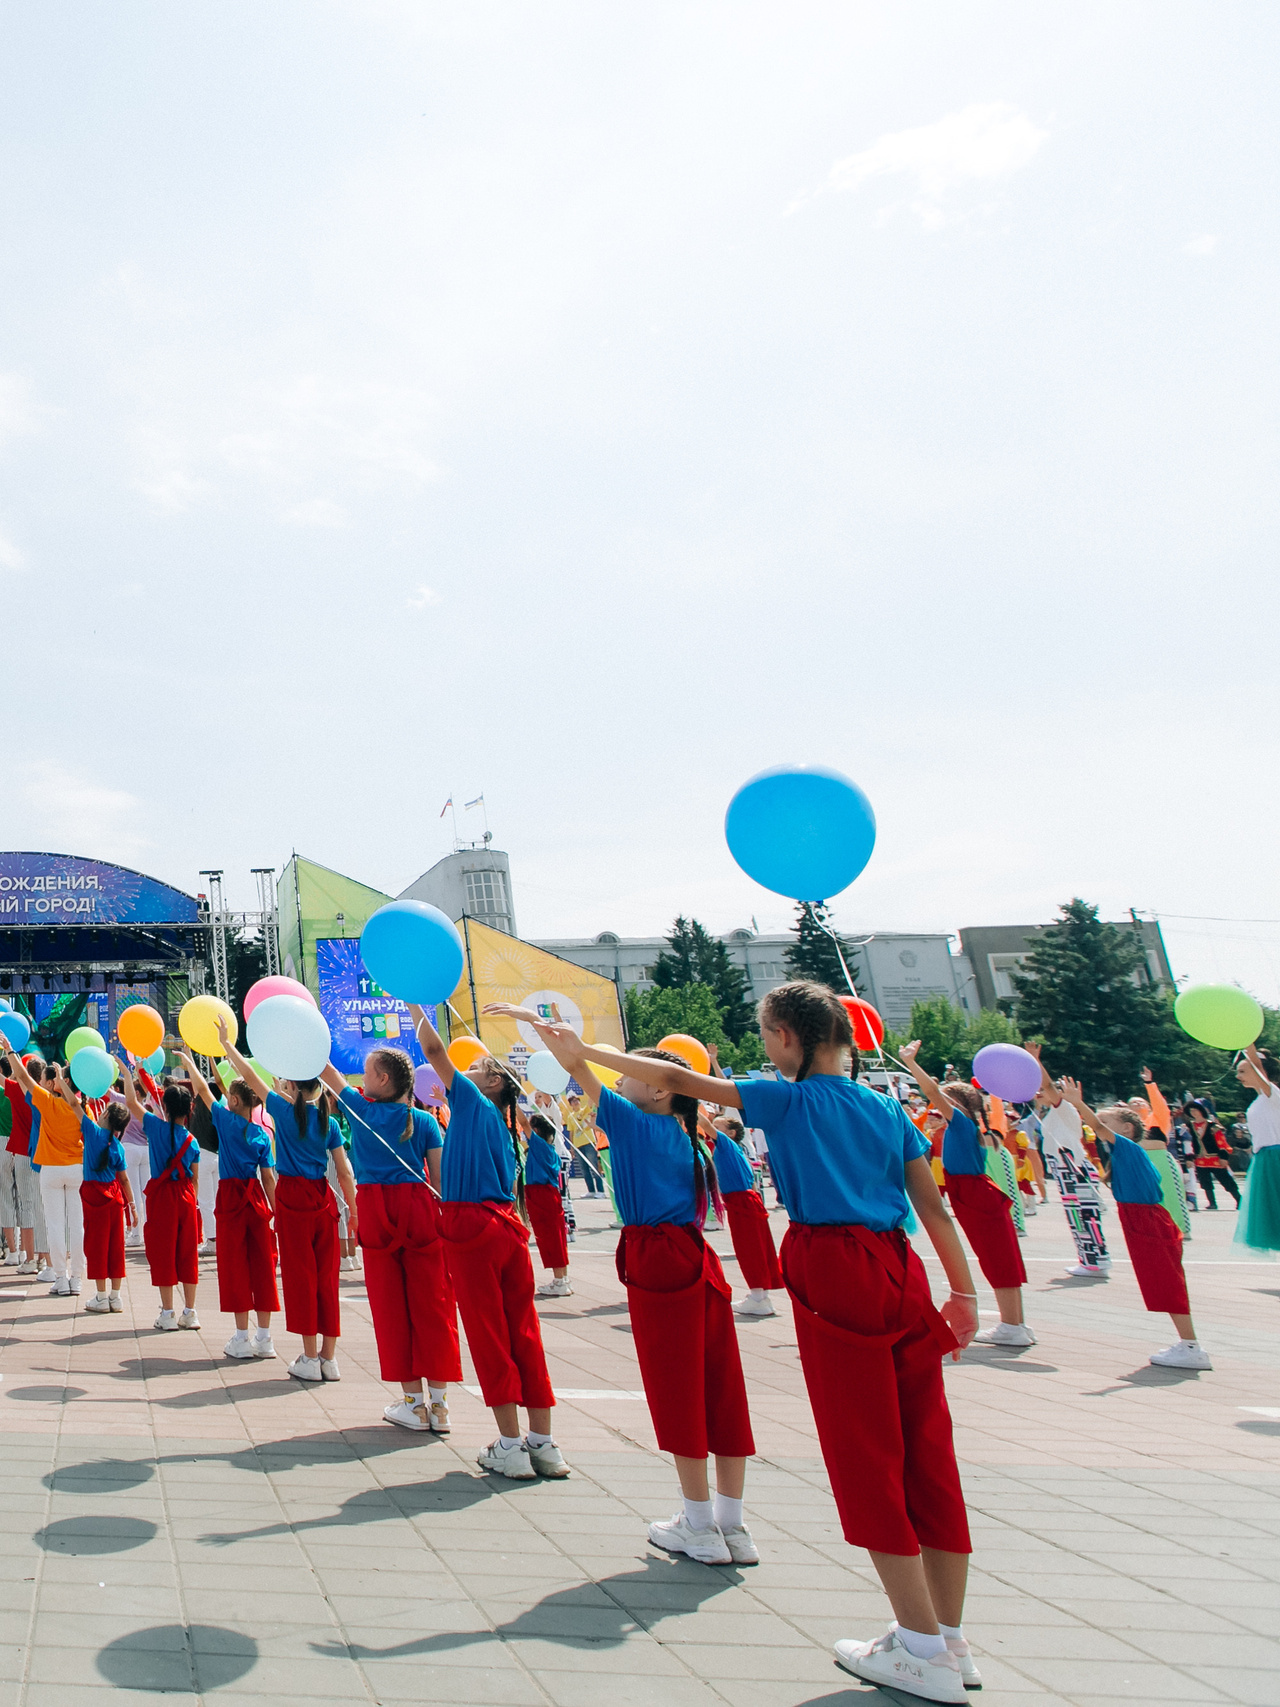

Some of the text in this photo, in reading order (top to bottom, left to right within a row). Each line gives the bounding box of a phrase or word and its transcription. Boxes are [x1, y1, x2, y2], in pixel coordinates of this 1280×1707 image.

[24, 897, 96, 914] ГОРОД!
[342, 1000, 409, 1012] УЛАН-УД
[361, 1016, 399, 1032] 356
